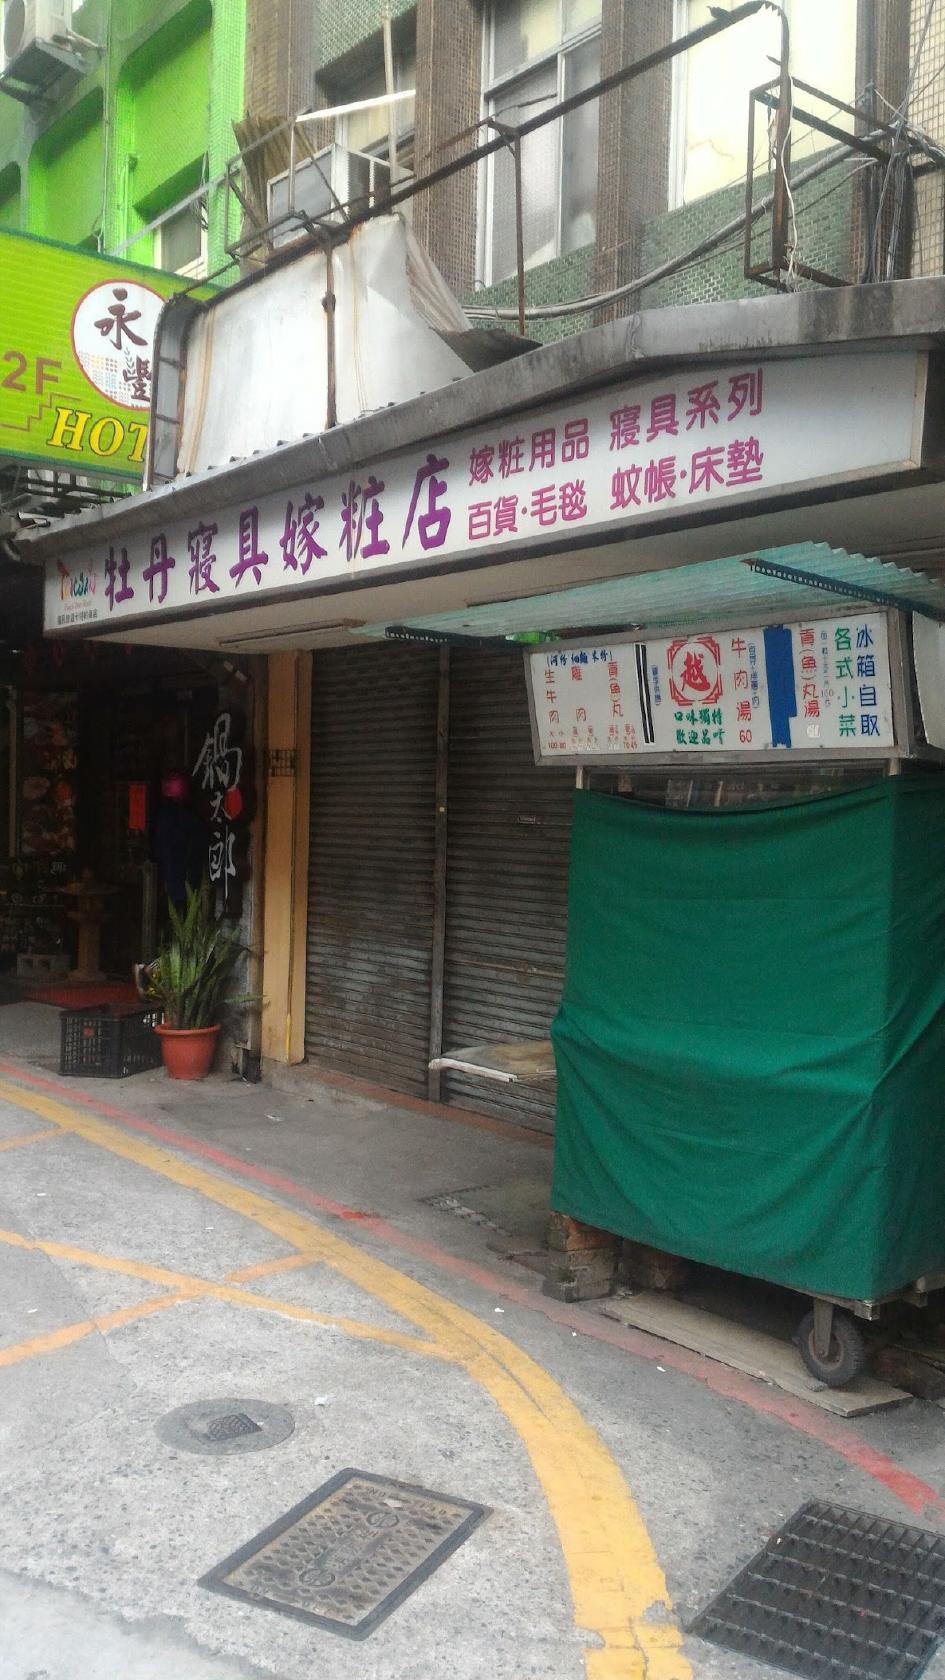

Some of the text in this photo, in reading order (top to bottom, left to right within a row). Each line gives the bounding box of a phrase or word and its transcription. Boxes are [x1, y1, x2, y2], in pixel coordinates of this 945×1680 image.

[1, 351, 62, 395] 2F
[468, 367, 763, 486] 嫁粧用品 寢具系列
[104, 453, 452, 611] 牡丹寢具嫁粧店
[544, 669, 560, 724] 生牛肉
[674, 708, 722, 726] 口味獨特
[731, 637, 752, 722] 牛肉湯
[834, 627, 856, 737] 各式小菜
[855, 623, 880, 737] 冰箱自取
[739, 729, 752, 743] 60
